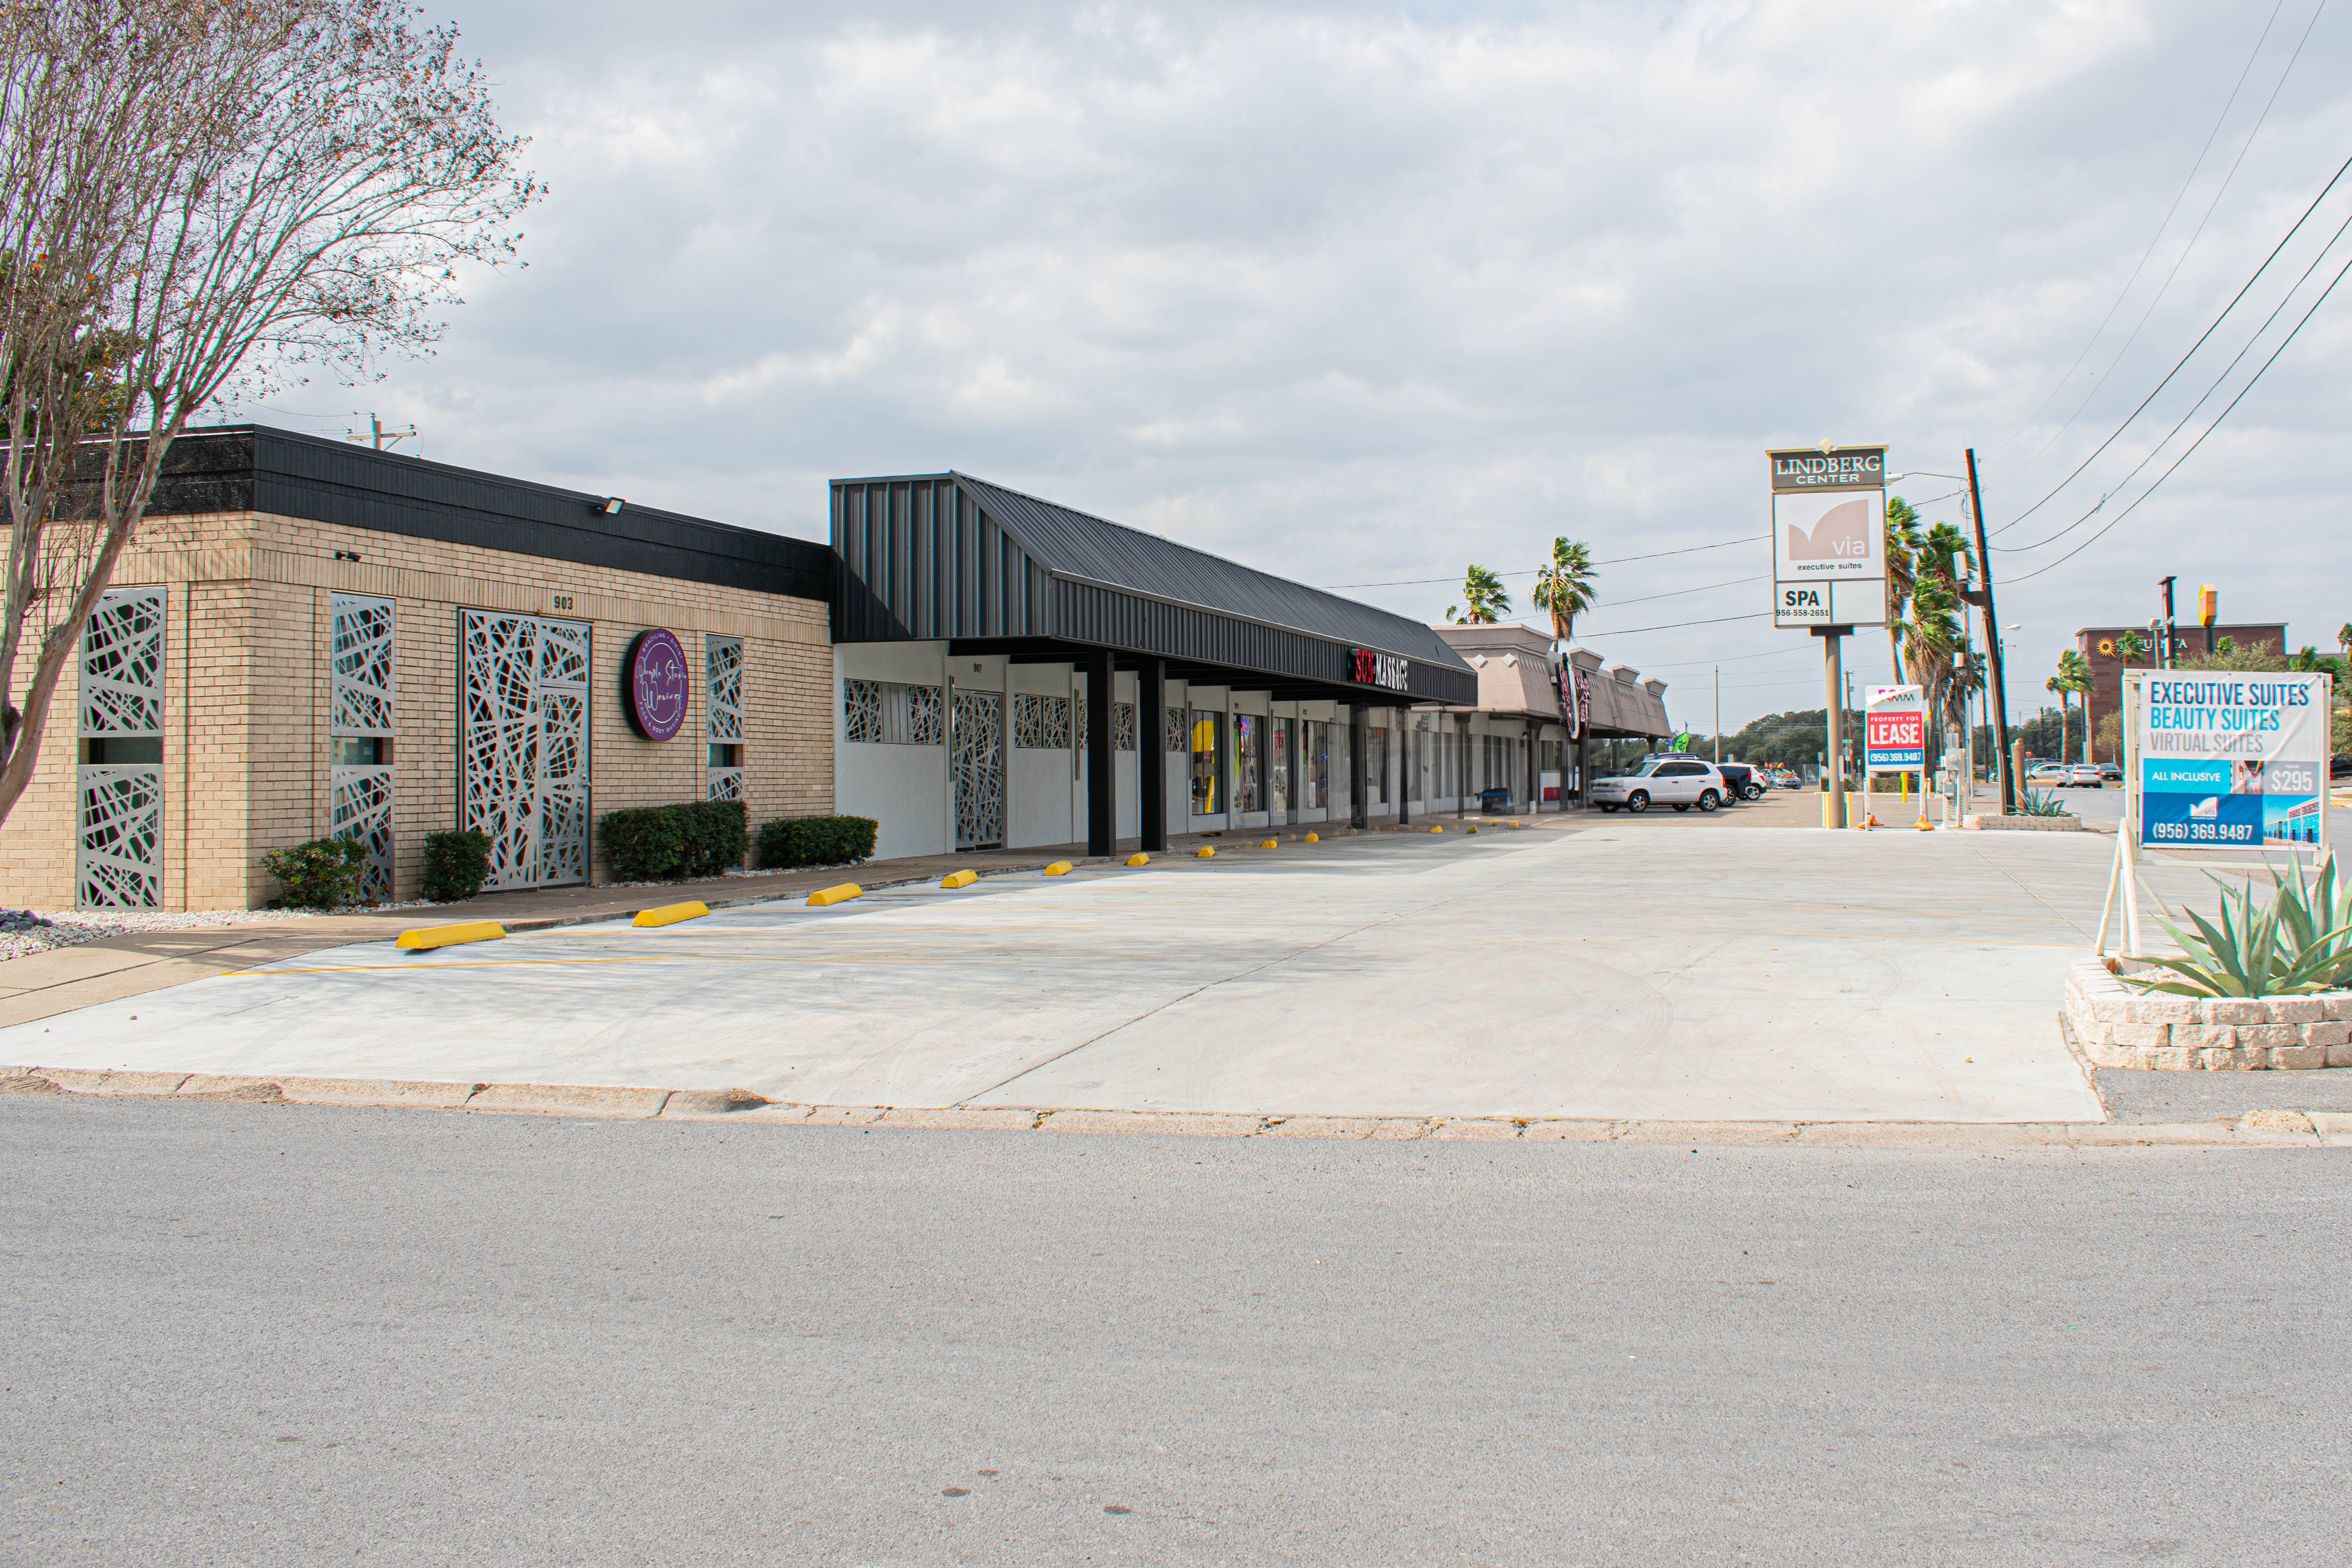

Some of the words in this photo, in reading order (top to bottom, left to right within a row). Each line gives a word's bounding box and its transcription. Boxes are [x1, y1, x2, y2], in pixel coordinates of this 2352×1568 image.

[1775, 456, 1881, 475] LINDBERG
[1796, 474, 1860, 484] CENTER
[1831, 536, 1865, 556] via
[554, 596, 573, 610] 903
[1785, 591, 1820, 607] SPA
[973, 663, 983, 673] 907
[1356, 649, 1373, 683] SUN
[1374, 653, 1408, 691] MASSAGE
[2151, 682, 2244, 705] EXECUTIVE
[2249, 683, 2309, 706] SUITES
[2151, 707, 2217, 730] BEAUTY
[2221, 708, 2280, 731] SUITES
[1870, 724, 1919, 744] LEASE
[2151, 732, 2210, 752] VIRTUAL
[2213, 733, 2263, 753] SUITES
[2152, 772, 2168, 781] ALL
[2171, 772, 2221, 782] INCLUSIVE
[2270, 769, 2313, 792] $295
[2153, 822, 2189, 840] (956)
[2190, 823, 2253, 840] 369.9487
